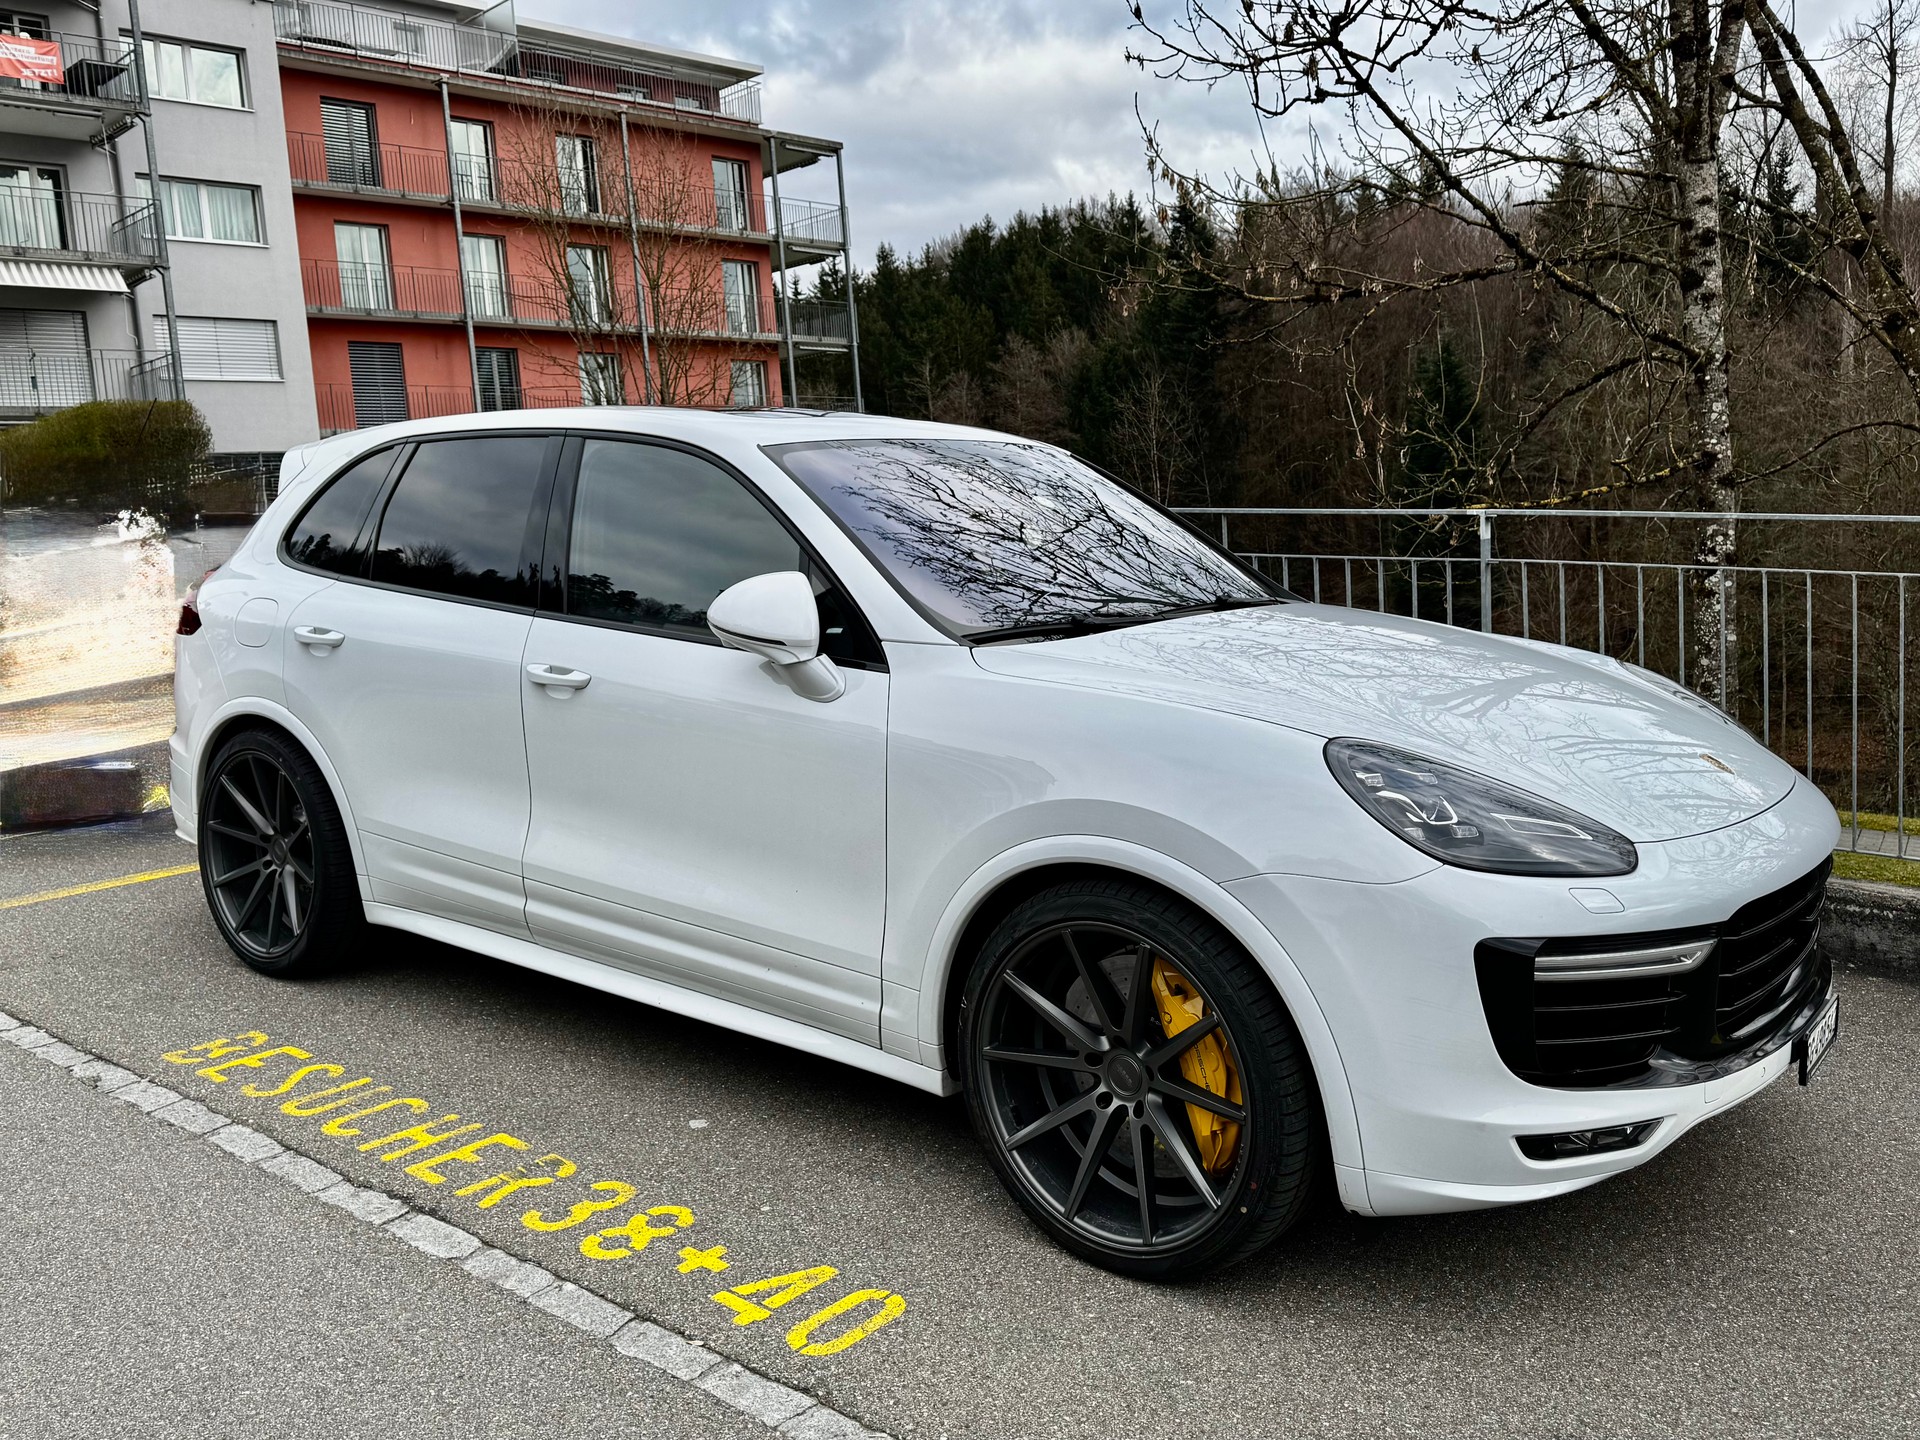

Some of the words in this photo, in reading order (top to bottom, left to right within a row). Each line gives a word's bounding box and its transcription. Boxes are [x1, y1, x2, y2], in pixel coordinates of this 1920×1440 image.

[22, 68, 58, 77] JETZT!
[1194, 1044, 1210, 1090] ORSCHE
[162, 1030, 579, 1210] BESUCHER
